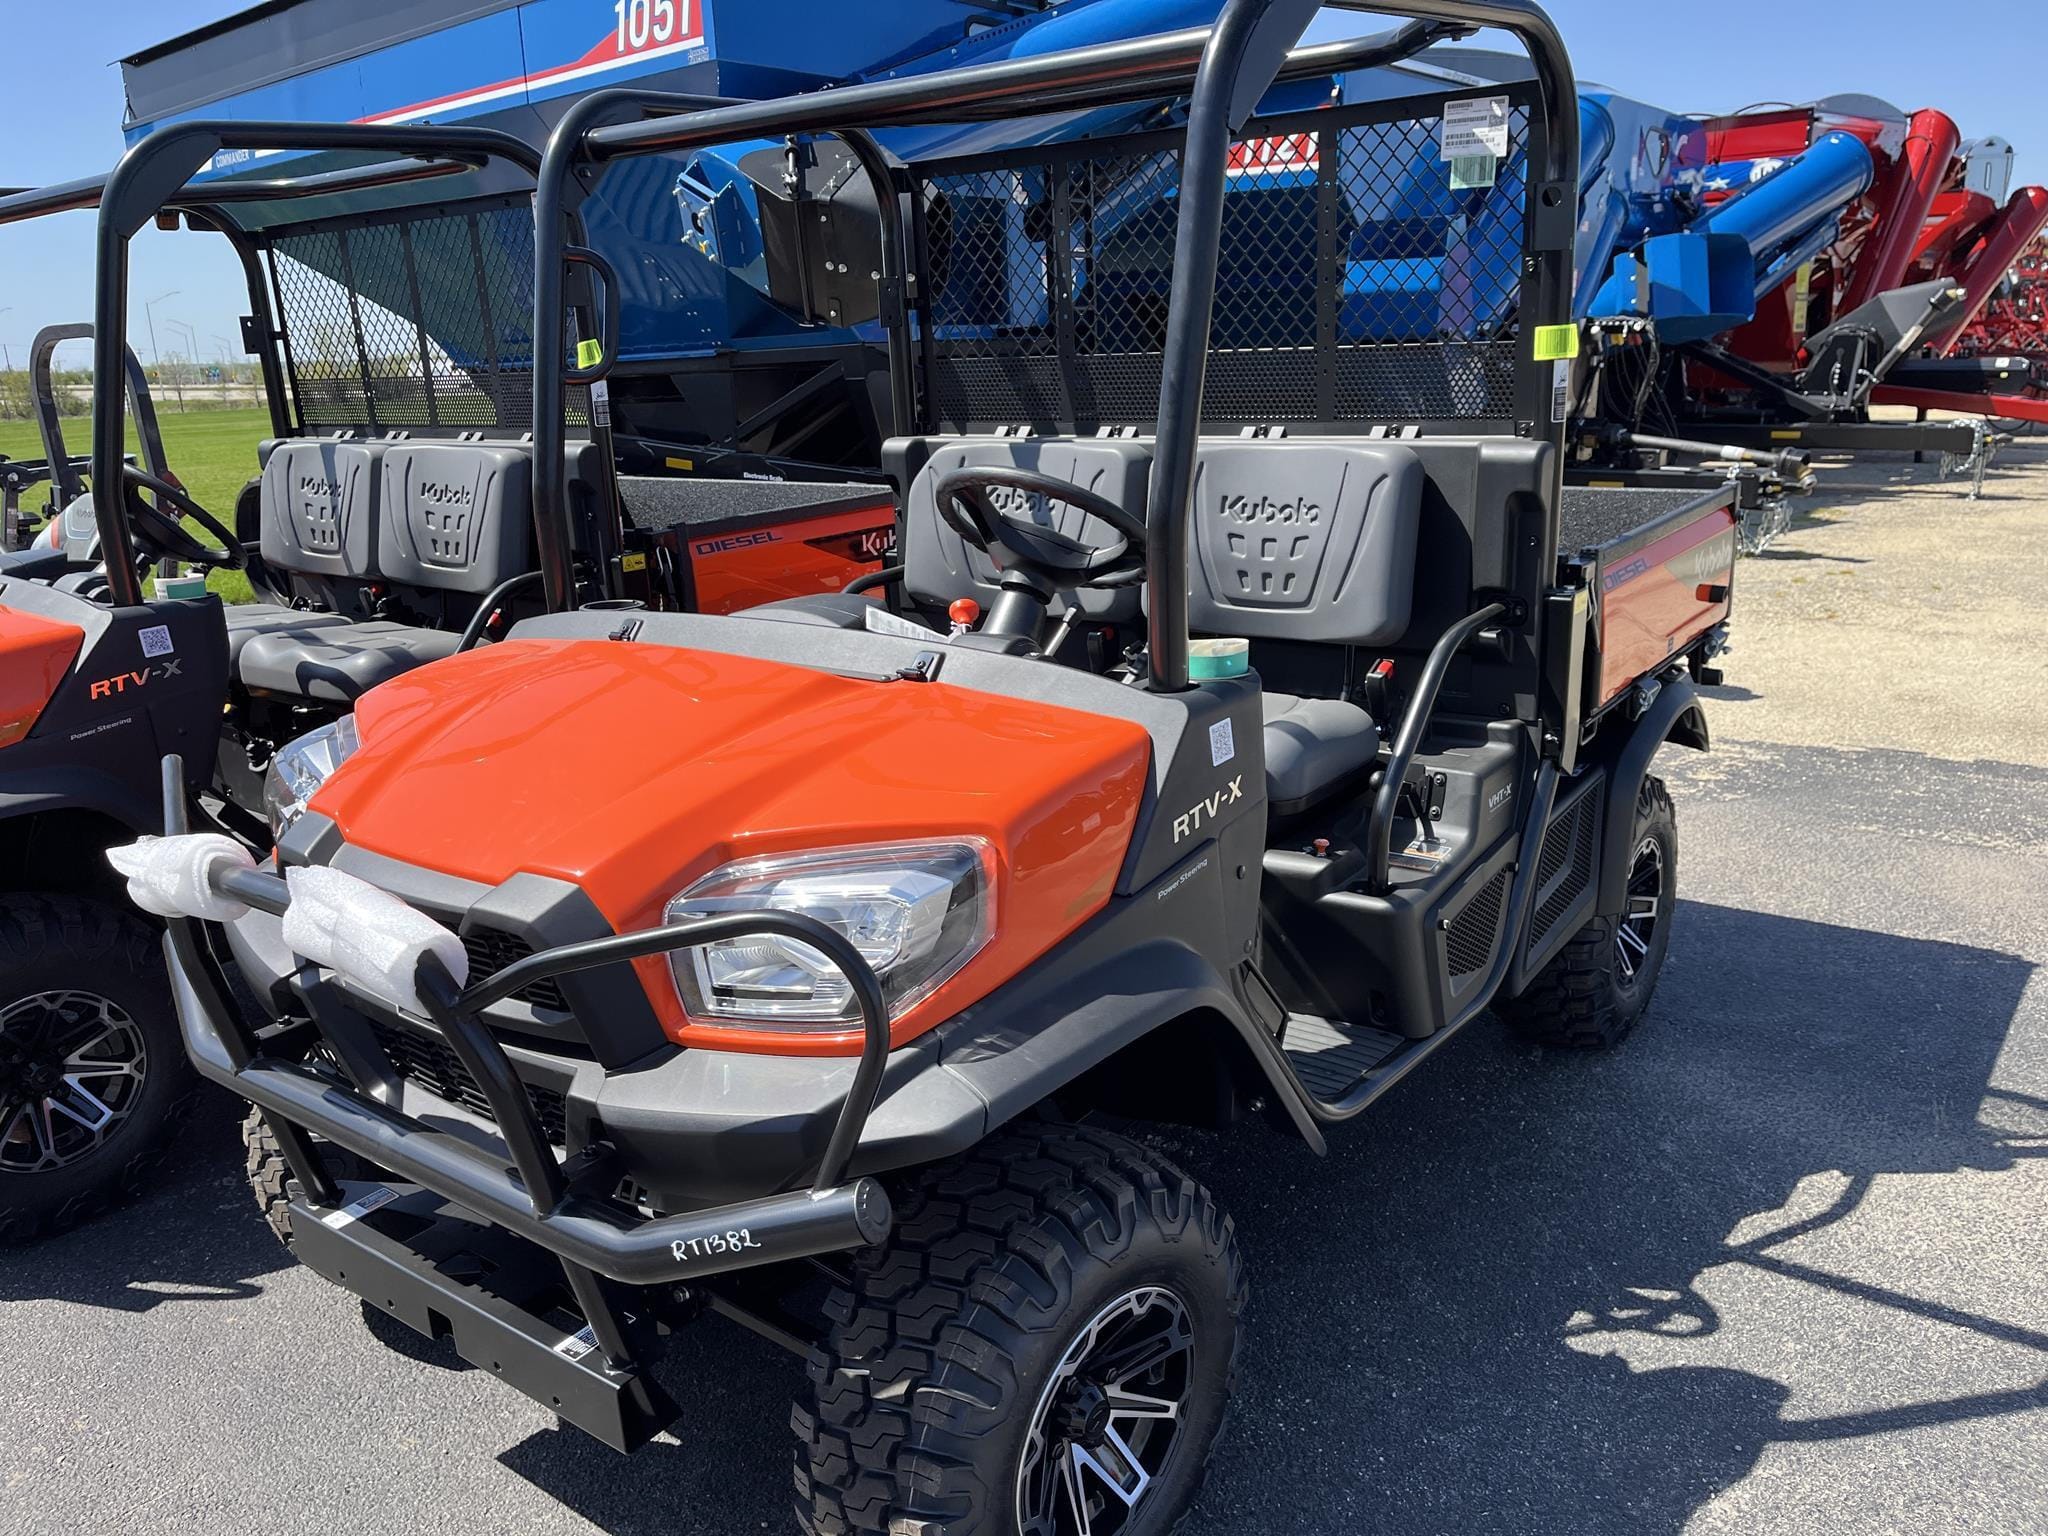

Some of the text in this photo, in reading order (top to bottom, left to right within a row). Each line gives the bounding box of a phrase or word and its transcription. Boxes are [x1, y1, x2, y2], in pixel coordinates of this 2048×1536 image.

[421, 482, 471, 507] Kubota
[1219, 495, 1321, 527] Kubota
[696, 531, 784, 555] DIESEL
[1602, 557, 1648, 592] DIESEL
[90, 658, 182, 700] RTV-X
[70, 717, 132, 741] Power Steering
[1172, 774, 1243, 844] RTV-X
[1487, 783, 1512, 809] VHT-X
[1157, 857, 1208, 900] Power Steering
